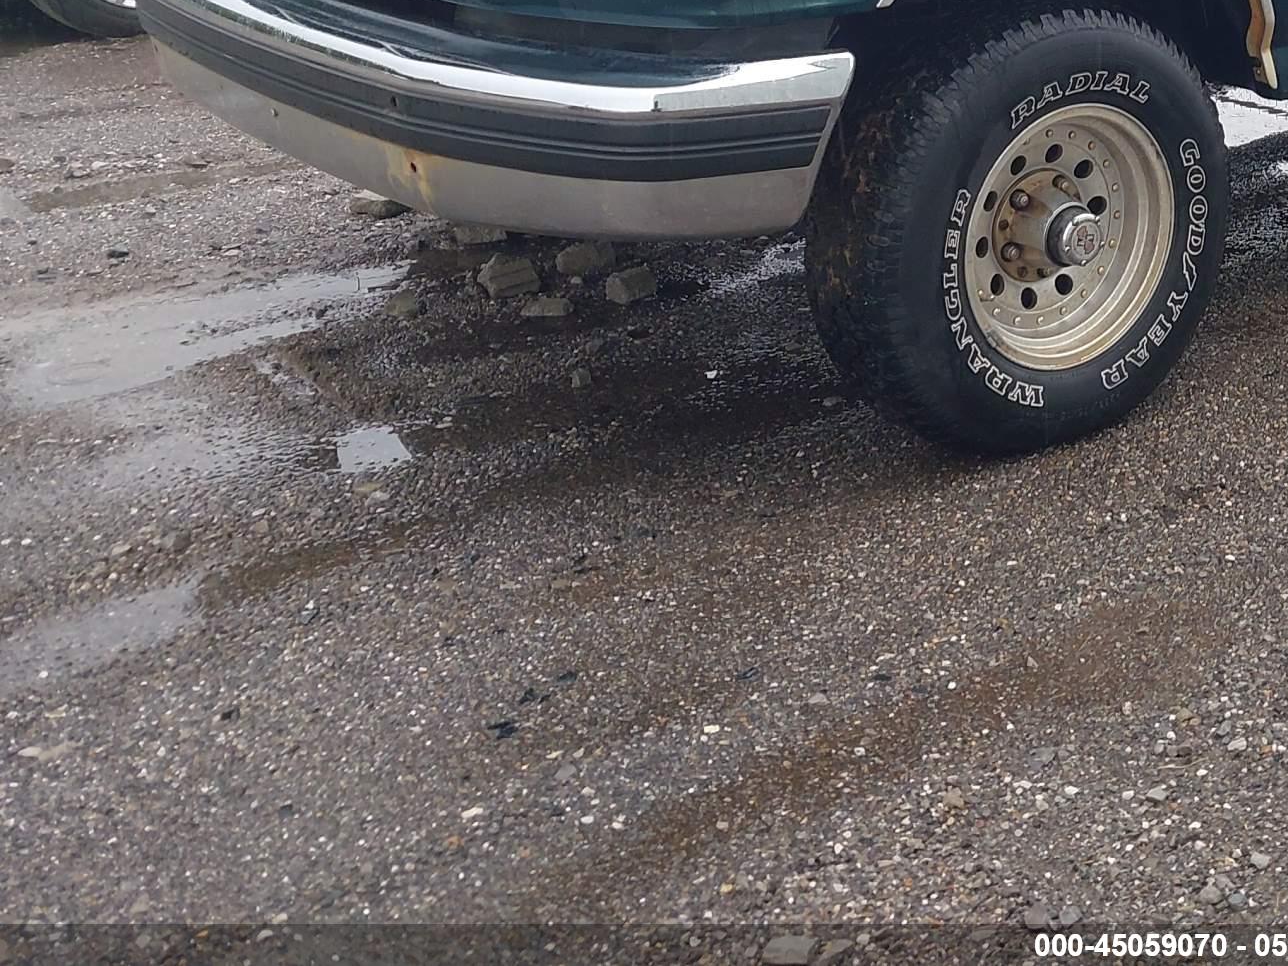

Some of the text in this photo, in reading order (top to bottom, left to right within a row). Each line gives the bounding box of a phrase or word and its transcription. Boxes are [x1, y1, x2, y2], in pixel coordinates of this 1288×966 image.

[1011, 71, 1151, 130] RADIAL
[943, 188, 1044, 407] WRANGLER
[1101, 138, 1209, 389] GOODYEAR
